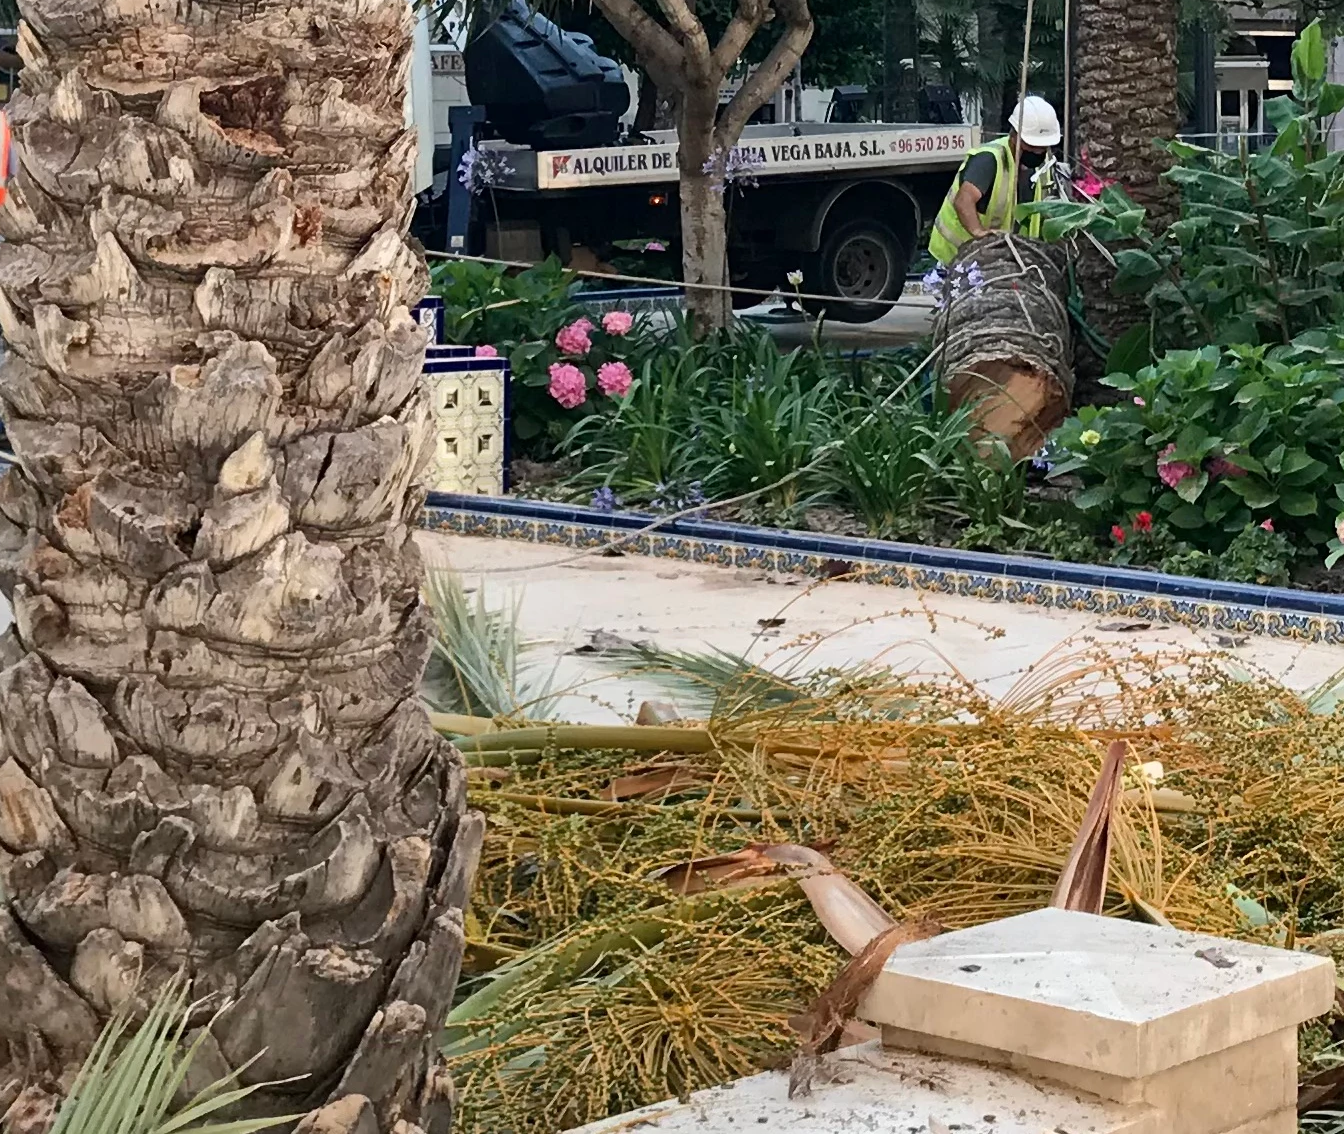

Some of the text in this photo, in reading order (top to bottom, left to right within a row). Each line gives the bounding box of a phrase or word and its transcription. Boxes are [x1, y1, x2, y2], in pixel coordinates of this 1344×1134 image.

[573, 153, 648, 176] ALQUILER
[651, 152, 673, 169] DE
[771, 142, 811, 162] VEGA
[814, 140, 856, 160] BAJA,
[859, 139, 886, 157] S.L.
[898, 138, 913, 153] 96
[915, 136, 934, 152] 570
[936, 135, 950, 150] 29
[951, 134, 965, 149] 56
